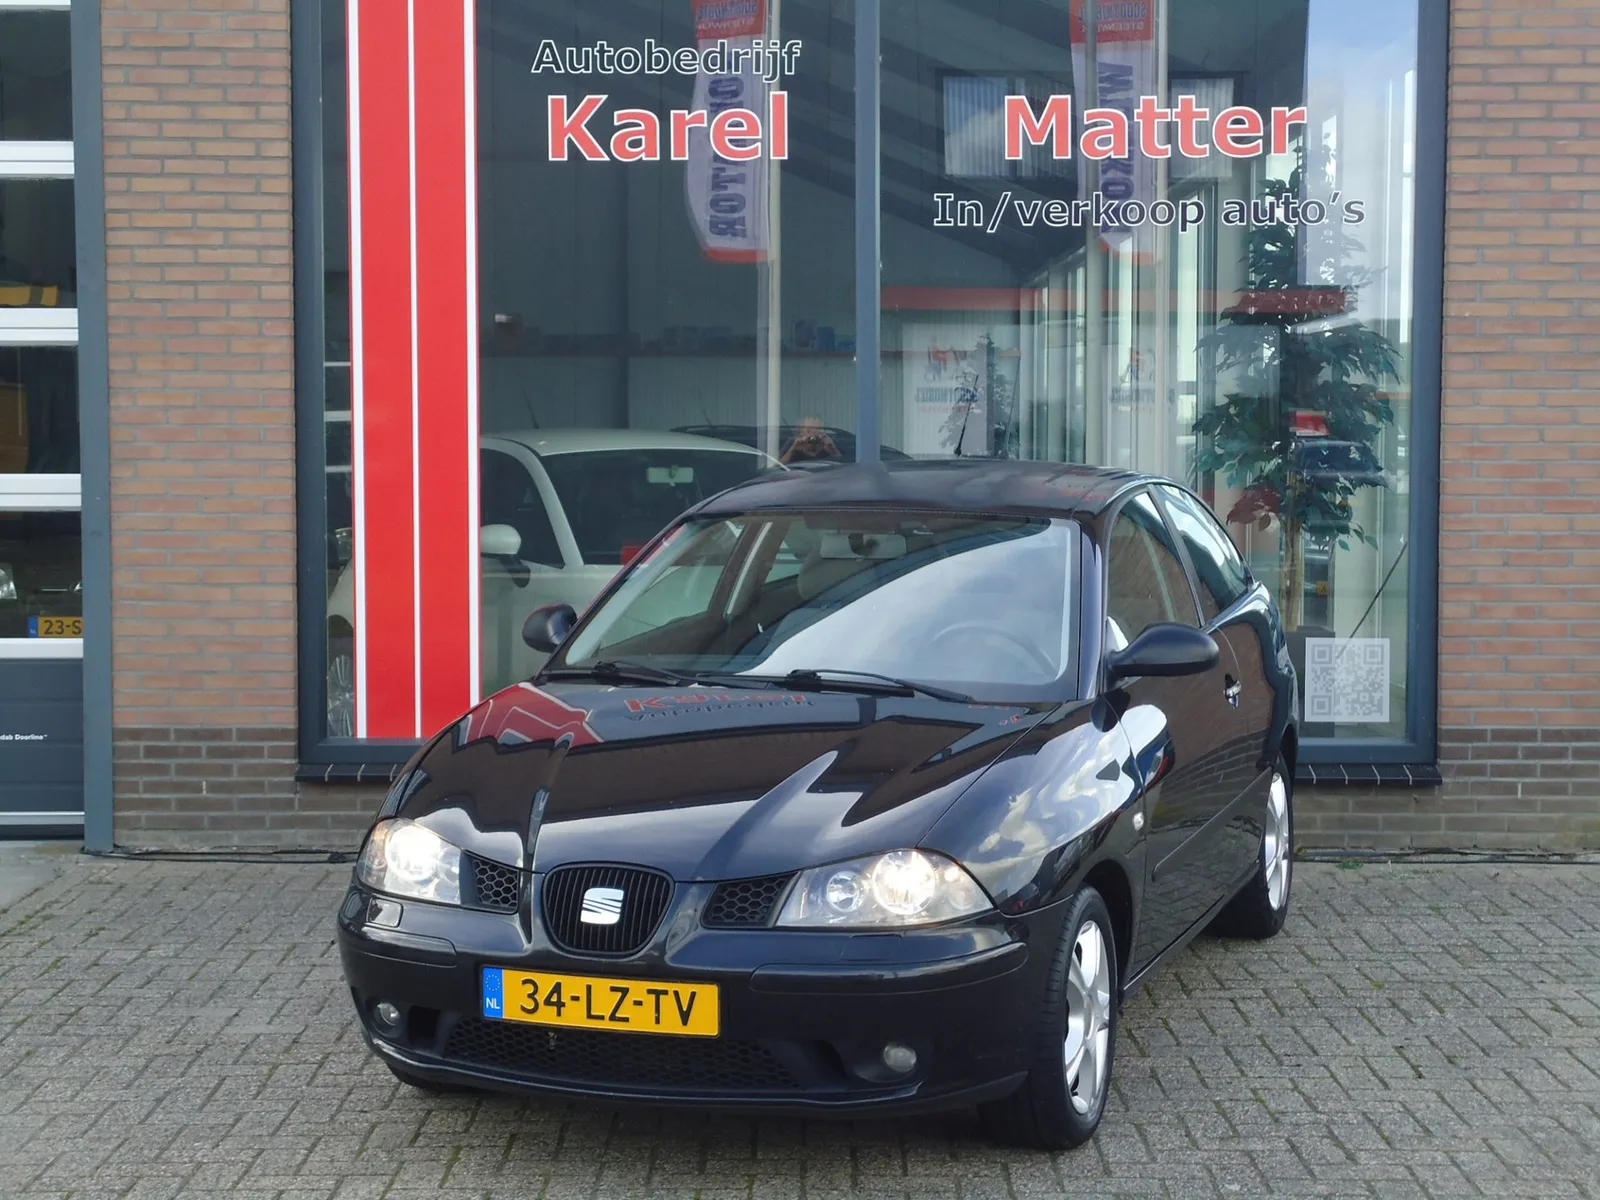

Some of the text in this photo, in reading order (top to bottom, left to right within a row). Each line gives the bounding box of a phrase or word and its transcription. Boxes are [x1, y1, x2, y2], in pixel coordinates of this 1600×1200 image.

[531, 39, 802, 83] Autobedrijf
[548, 91, 1308, 161] Karel Matter
[933, 191, 1366, 234] In/verkoop auto's
[486, 997, 501, 1009] NL
[520, 978, 697, 1027] 34-LZ-TV
